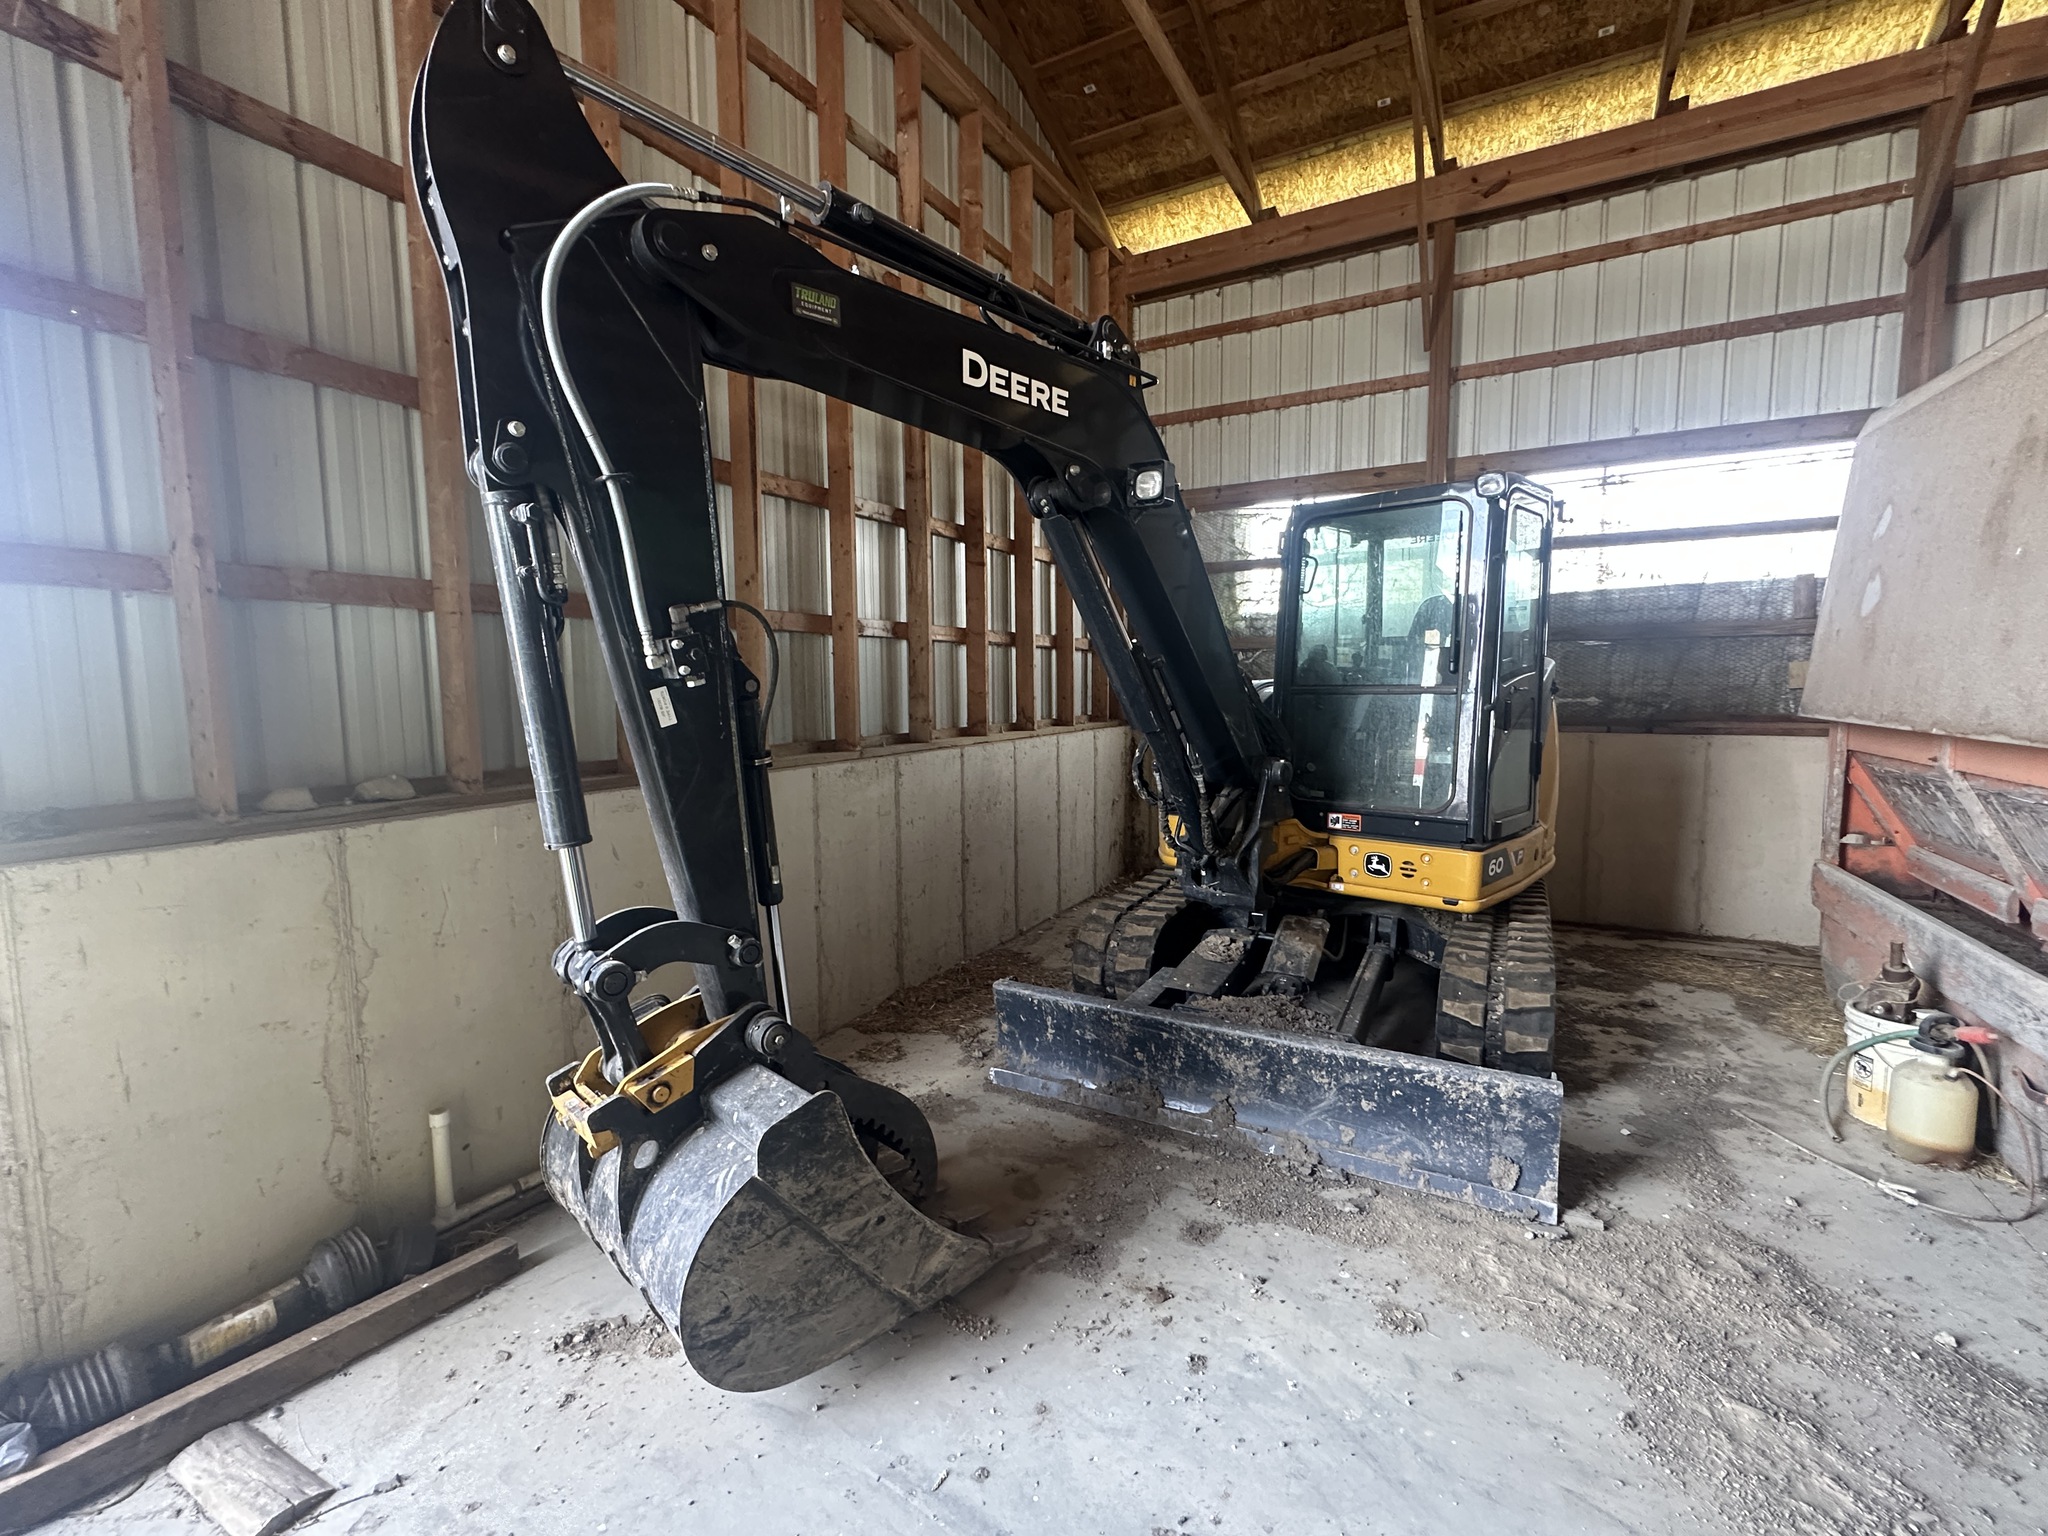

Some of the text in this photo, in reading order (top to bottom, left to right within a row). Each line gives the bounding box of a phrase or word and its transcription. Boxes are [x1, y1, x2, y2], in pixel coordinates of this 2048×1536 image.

[794, 287, 837, 309] TRULAND
[800, 301, 832, 314] EQUIPMENT
[962, 348, 1069, 417] DEERE
[1488, 856, 1504, 876] 60
